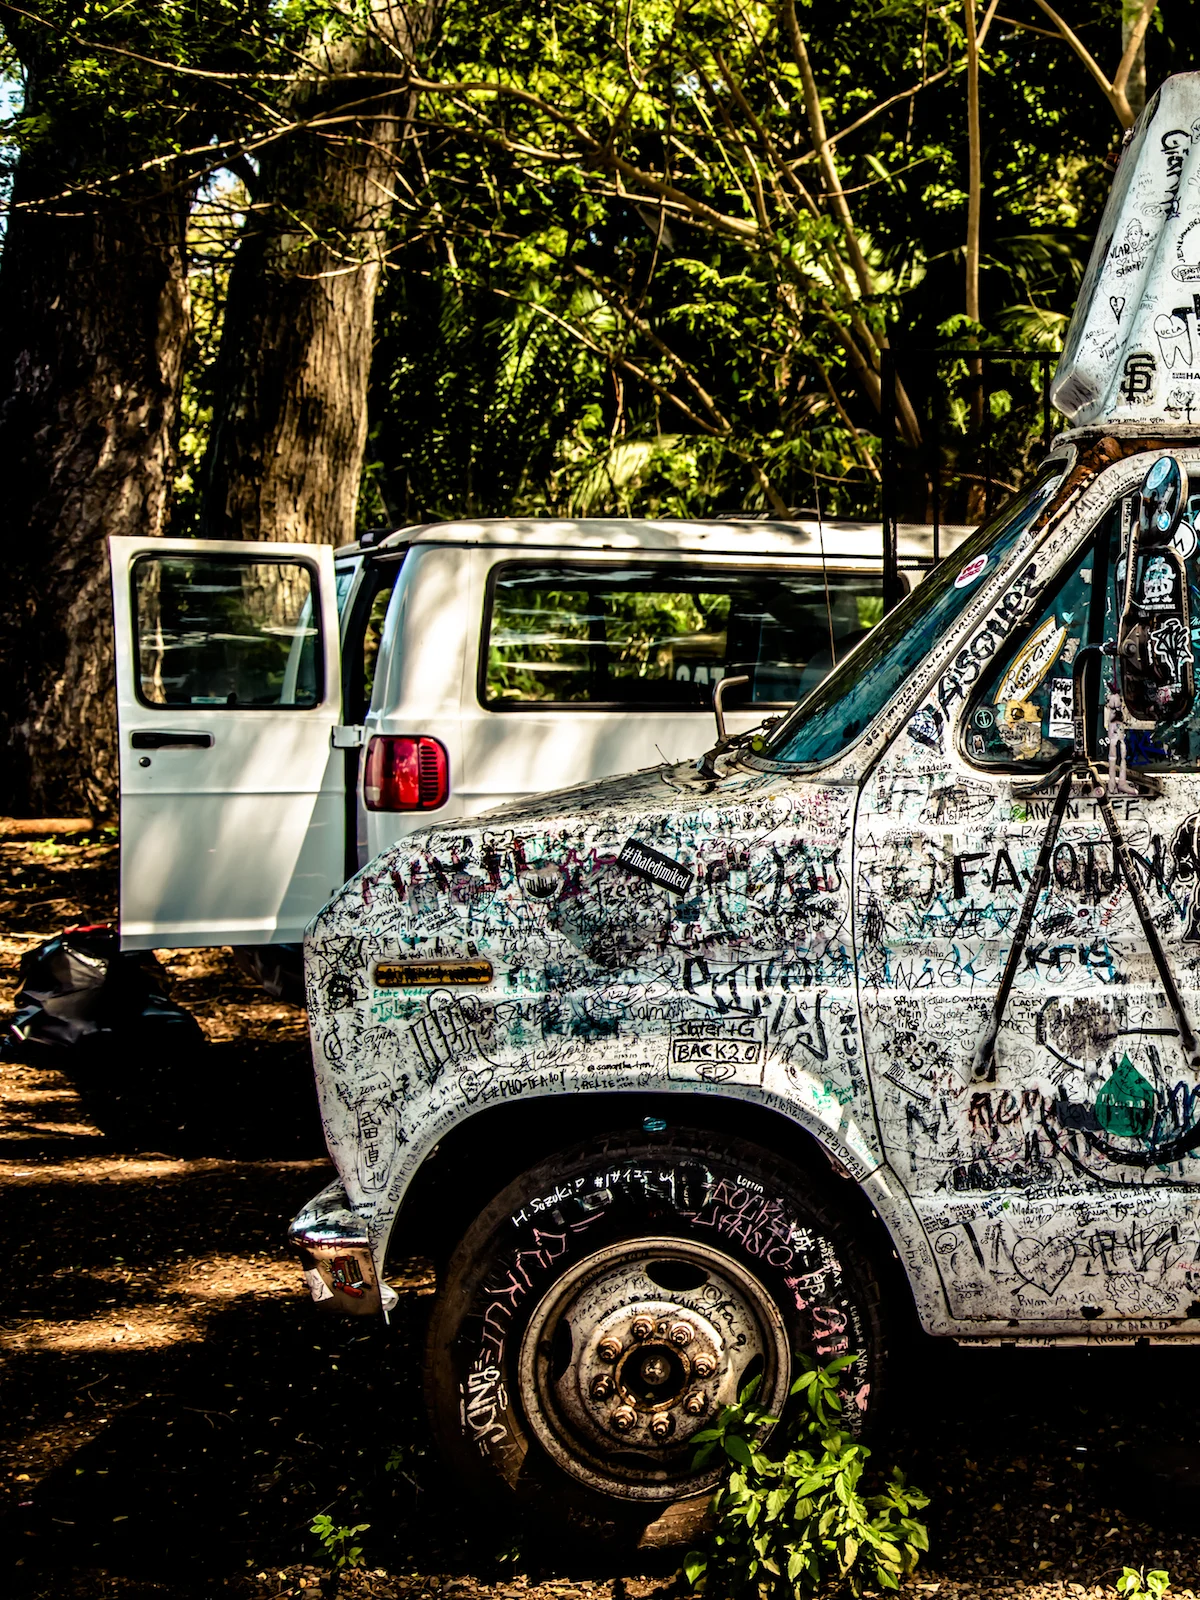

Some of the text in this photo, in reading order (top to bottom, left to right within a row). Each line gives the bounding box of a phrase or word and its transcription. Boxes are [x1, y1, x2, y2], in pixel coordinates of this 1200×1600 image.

[1160, 327, 1183, 336] UCLA
[918, 763, 952, 774] Madeline
[621, 845, 690, 892] #ihatedjmiked
